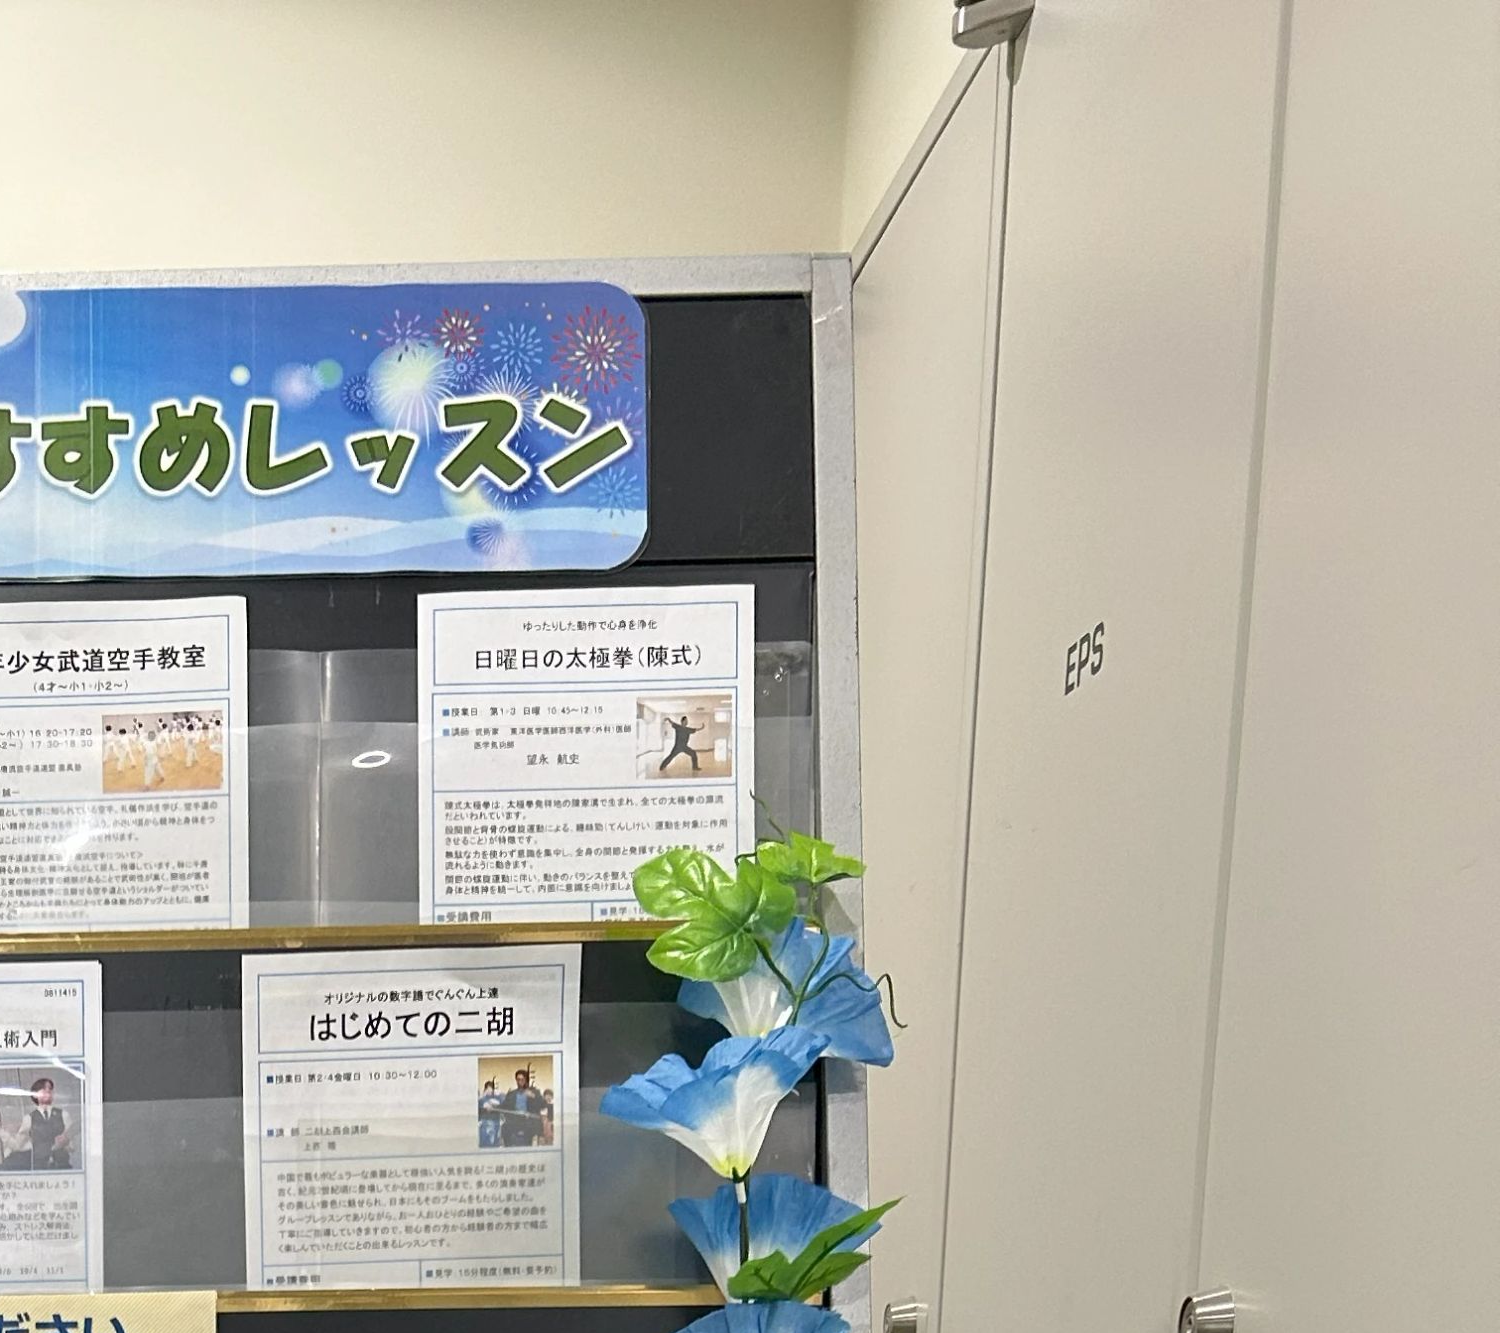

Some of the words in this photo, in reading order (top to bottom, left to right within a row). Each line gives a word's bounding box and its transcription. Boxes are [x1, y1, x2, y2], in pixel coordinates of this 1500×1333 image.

[474, 644, 704, 671] 日曜日の太極拳(陳式)
[1064, 621, 1105, 696] EPS
[310, 1007, 515, 1042] はじめての二胡
